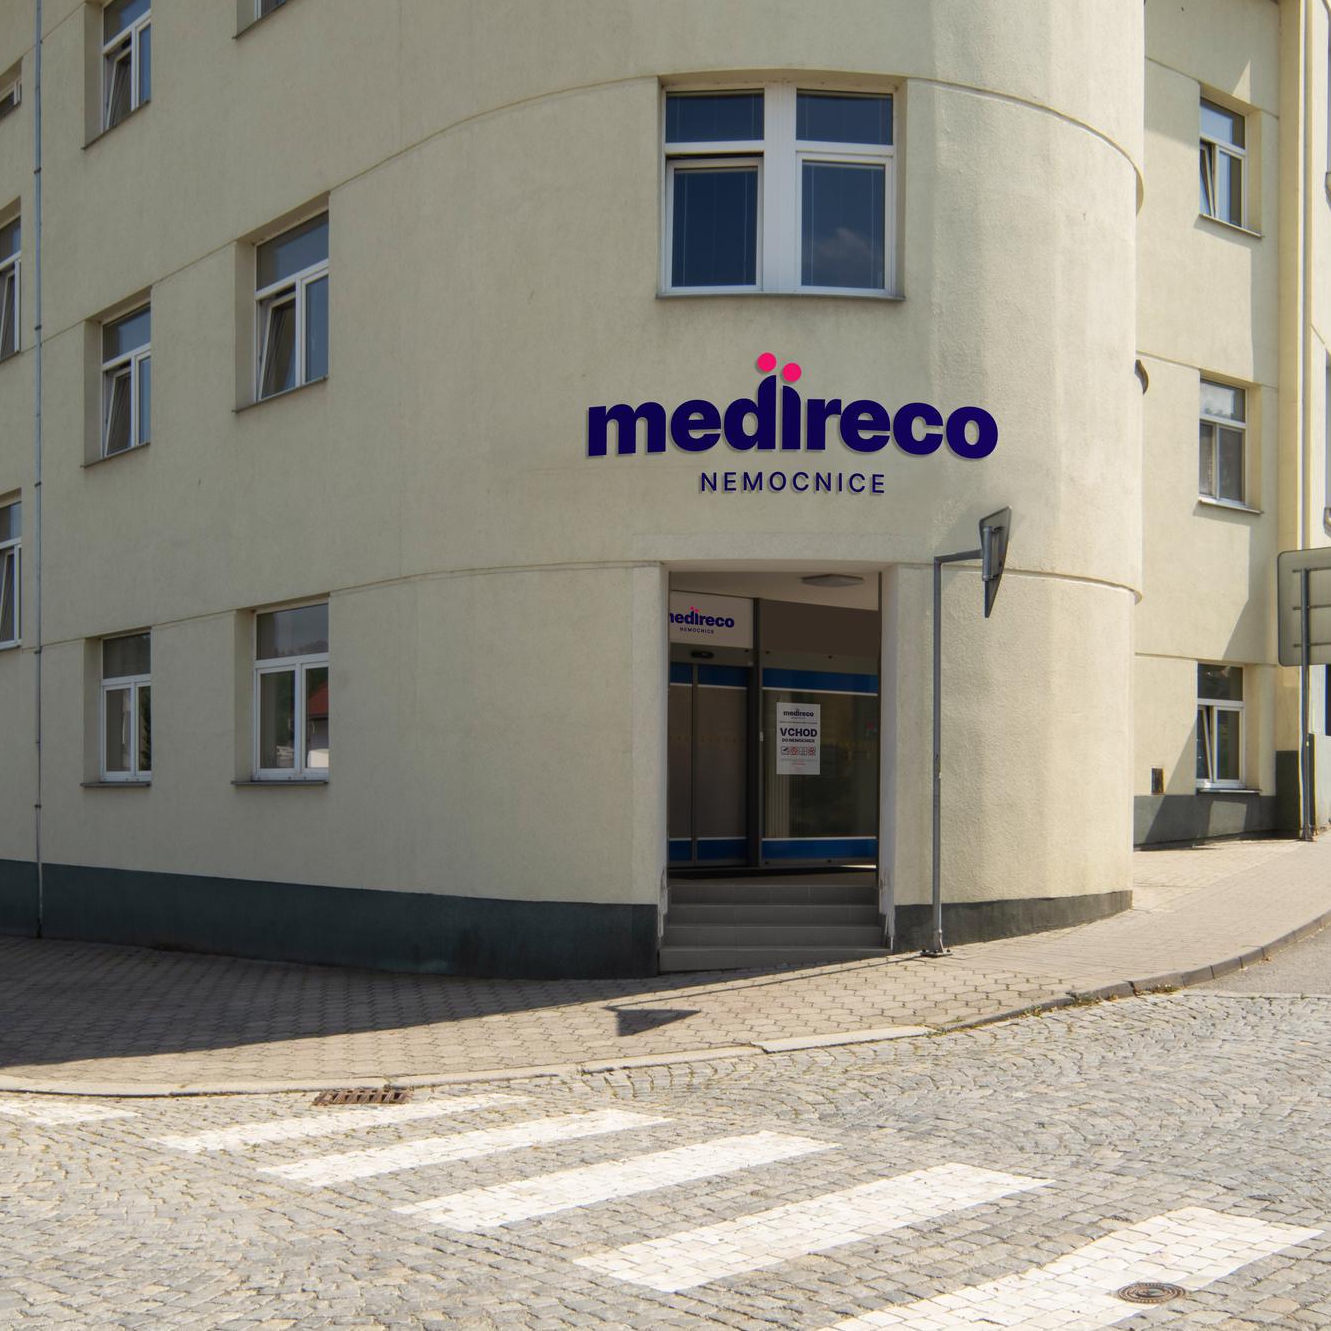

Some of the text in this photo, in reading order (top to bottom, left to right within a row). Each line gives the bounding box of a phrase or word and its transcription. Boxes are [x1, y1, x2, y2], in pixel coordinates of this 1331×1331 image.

[587, 352, 999, 459] medireco
[700, 471, 886, 494] NEMOCNICE
[783, 708, 814, 717] medireco
[780, 727, 818, 737] VCHOD
